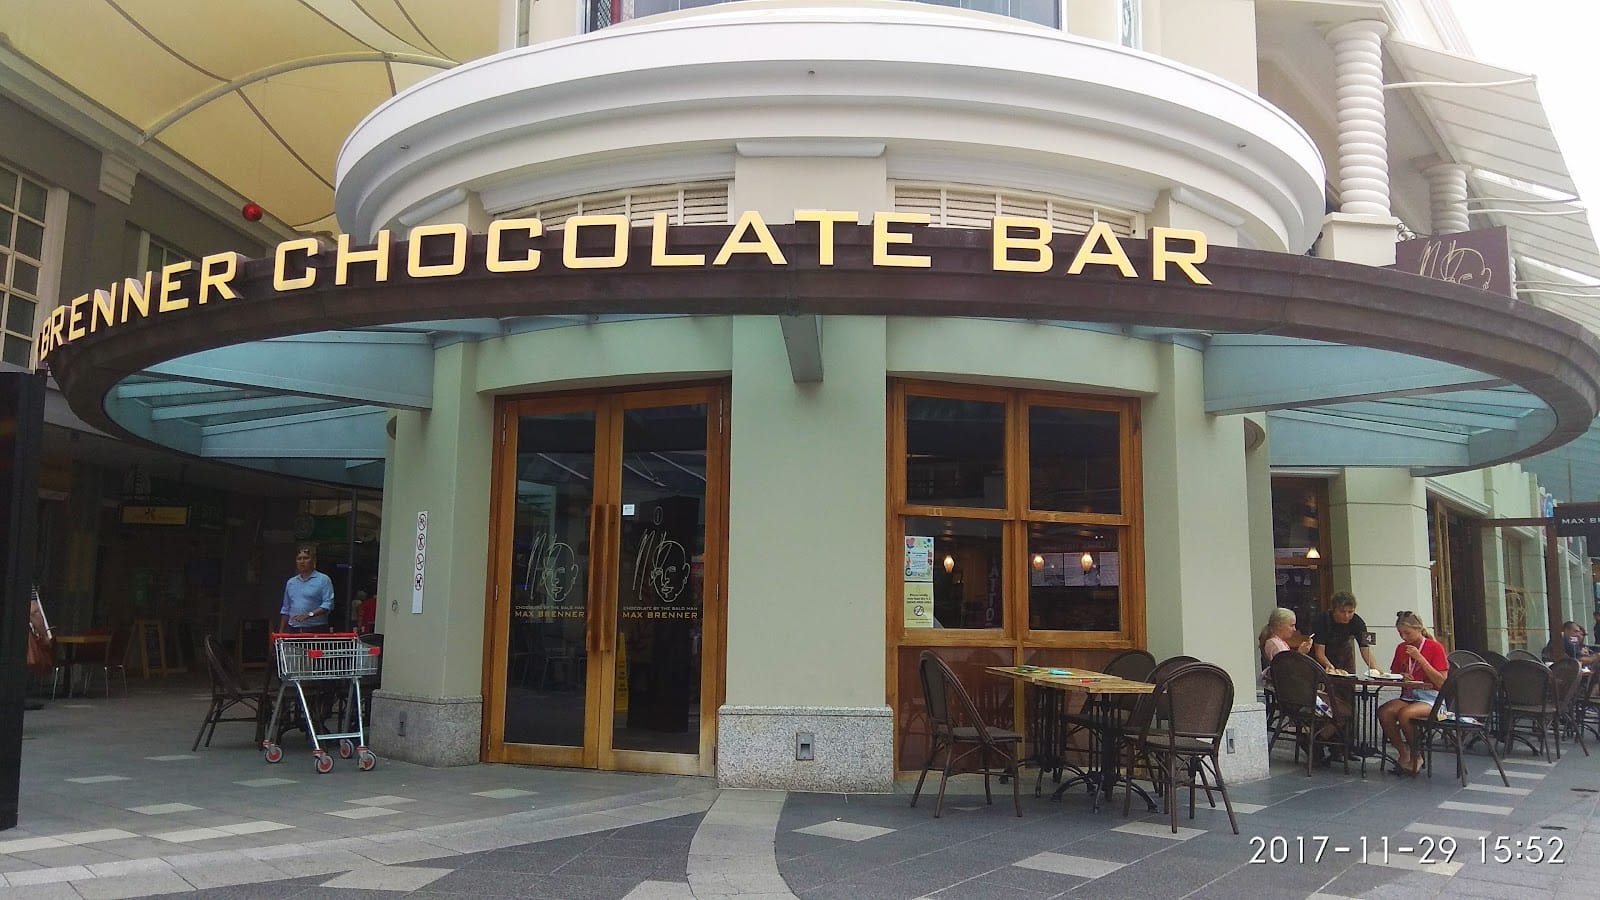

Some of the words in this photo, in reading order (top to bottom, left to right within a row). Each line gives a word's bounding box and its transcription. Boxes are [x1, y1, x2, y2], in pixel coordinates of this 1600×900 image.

[40, 251, 237, 361] BRENNER
[273, 209, 931, 291] CHOCOLATE
[993, 216, 1212, 285] BAR
[514, 610, 534, 618] MAX
[538, 610, 585, 618] BRENNER
[622, 611, 643, 619] MAX
[647, 611, 698, 619] BRENNER
